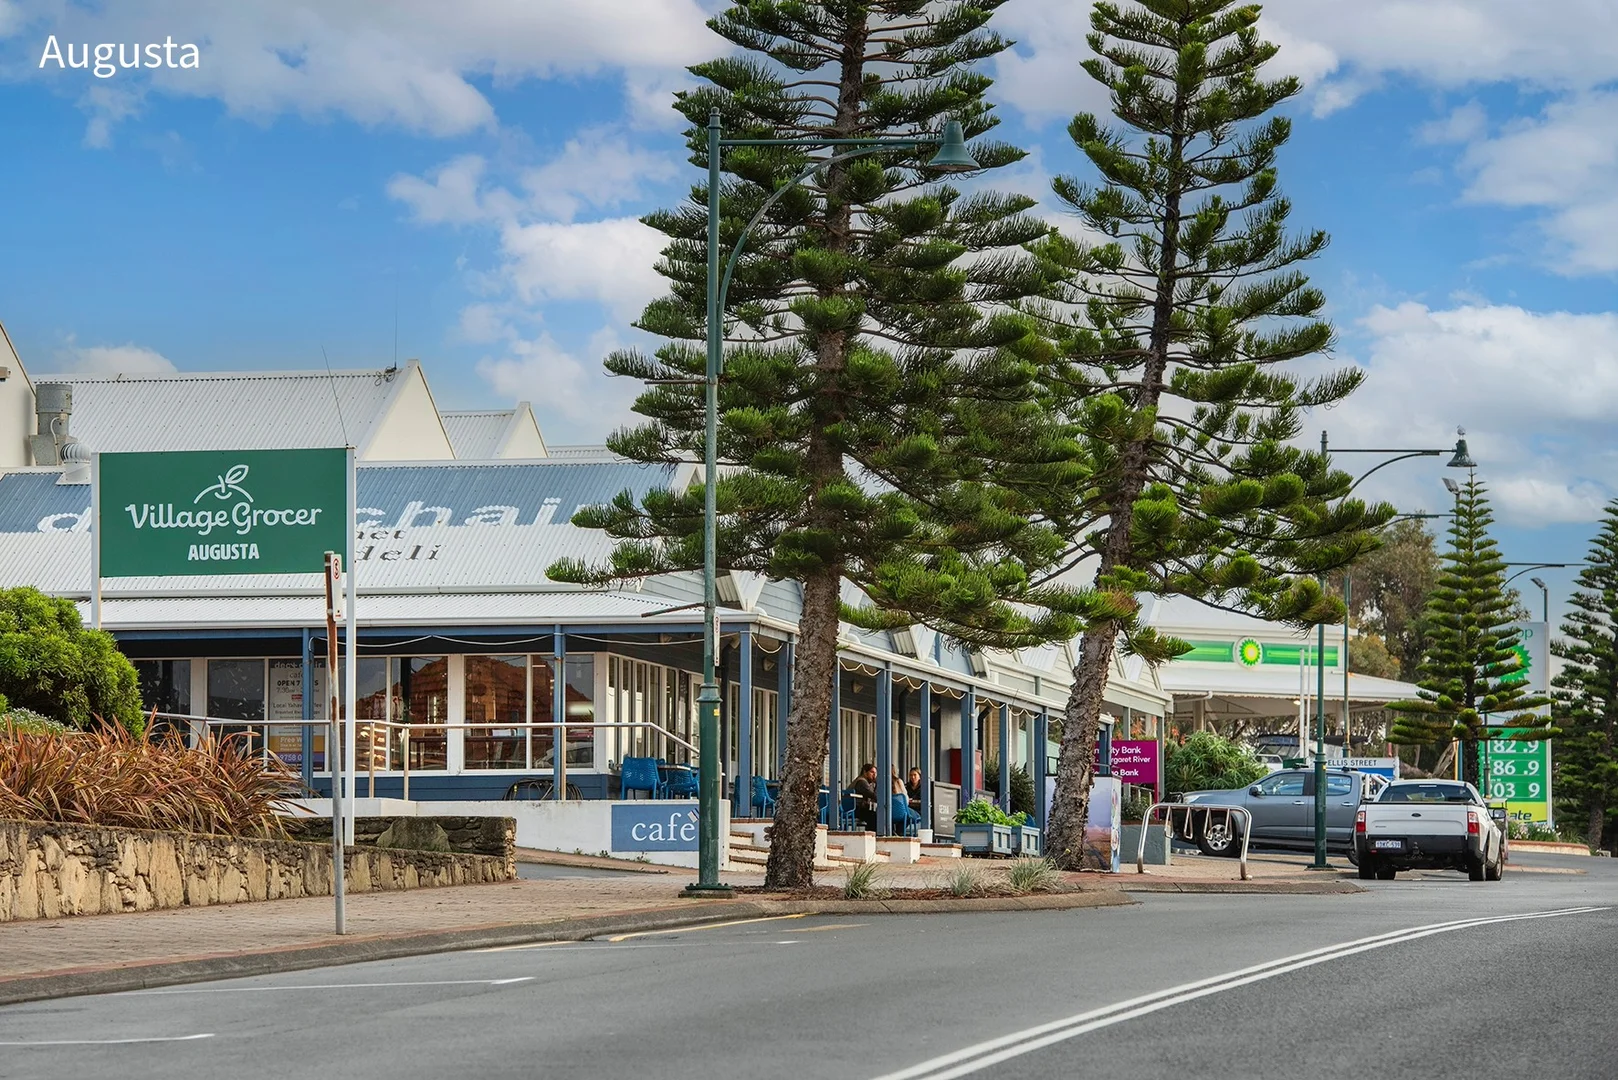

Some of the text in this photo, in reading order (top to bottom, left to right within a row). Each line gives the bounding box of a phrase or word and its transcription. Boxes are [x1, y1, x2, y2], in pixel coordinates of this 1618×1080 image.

[125, 504, 229, 536] Village
[232, 502, 322, 535] Grocer
[188, 543, 259, 561] AUGUSTA
[1121, 745, 1141, 754] Bank
[1132, 755, 1150, 763] River
